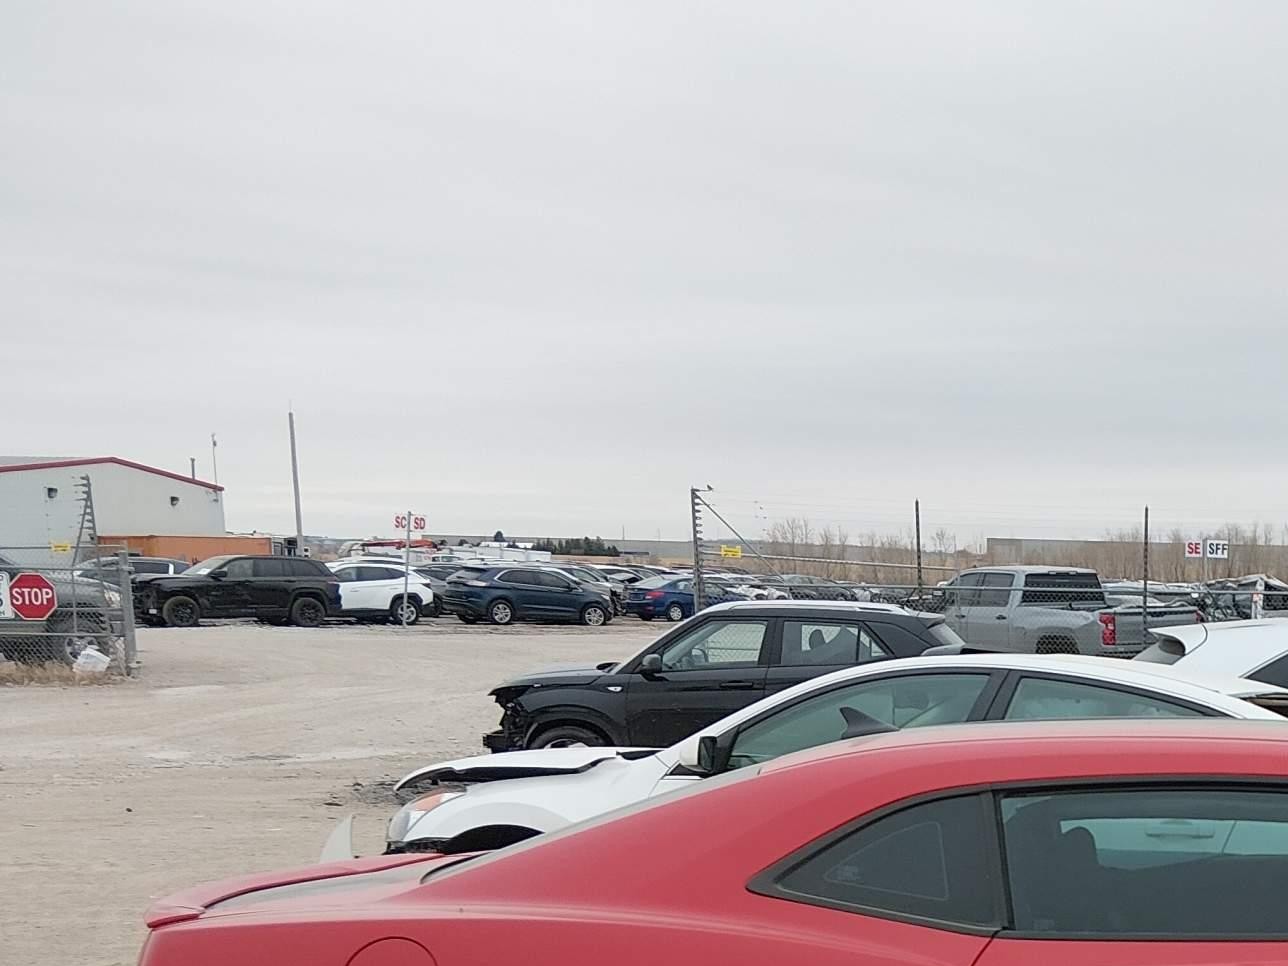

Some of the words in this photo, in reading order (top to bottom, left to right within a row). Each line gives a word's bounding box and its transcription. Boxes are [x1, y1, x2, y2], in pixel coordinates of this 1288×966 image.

[394, 516, 407, 528] SC
[414, 516, 425, 529] SD
[1187, 542, 1201, 554] SE
[1208, 542, 1228, 555] SFF
[12, 587, 53, 605] STOP
